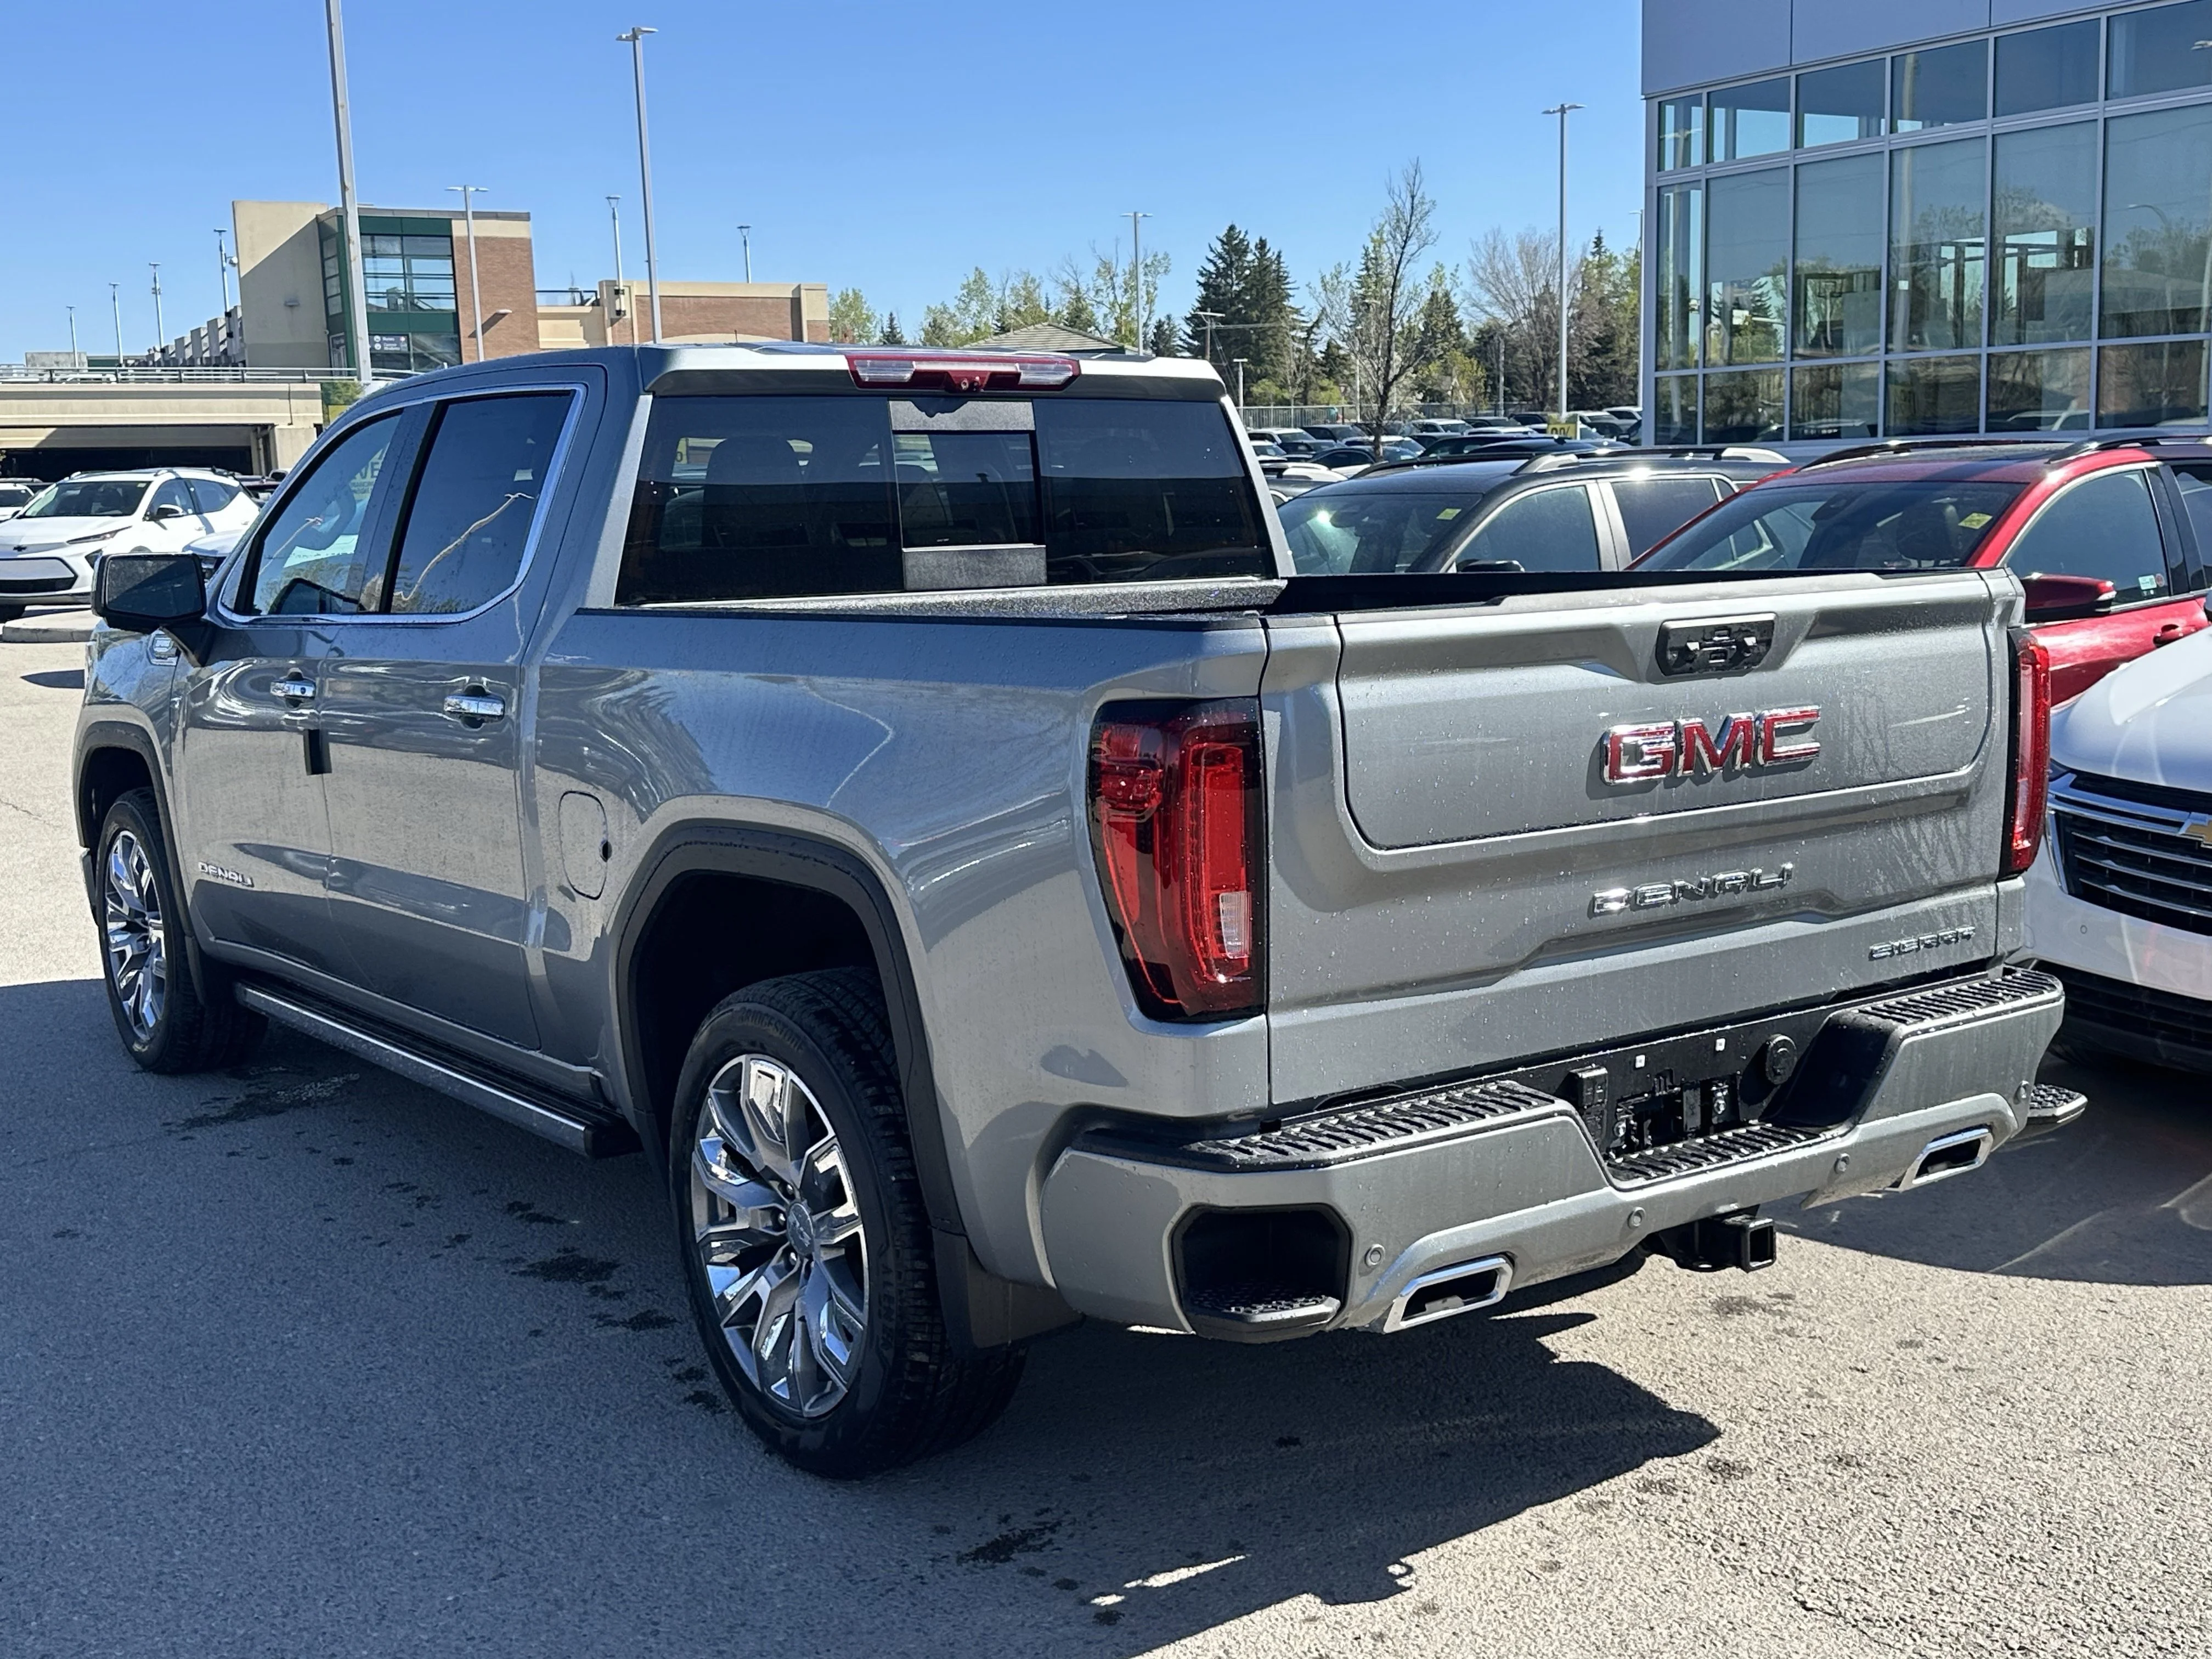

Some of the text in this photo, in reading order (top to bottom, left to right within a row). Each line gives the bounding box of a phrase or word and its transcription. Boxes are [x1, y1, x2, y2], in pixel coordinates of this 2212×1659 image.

[1601, 705, 1821, 786] GMC
[198, 861, 254, 887] DENALI
[1594, 862, 1793, 913] DENALI
[1869, 926, 1975, 958] SIERRA
